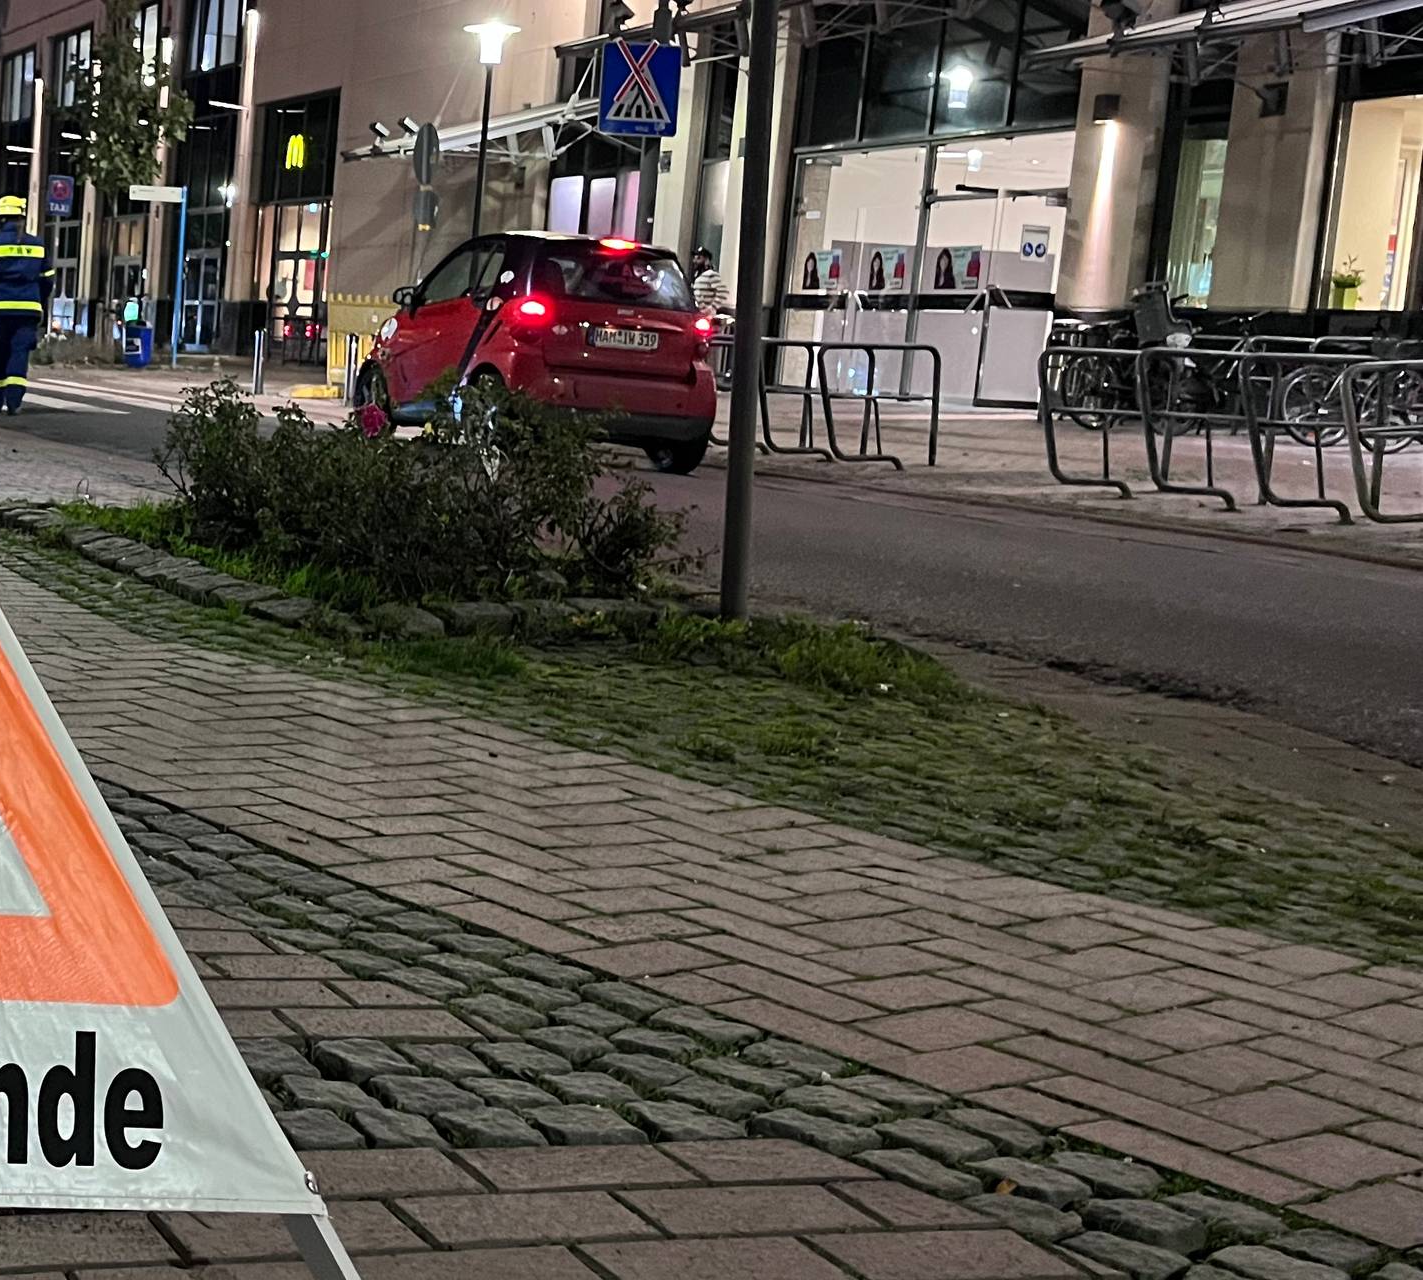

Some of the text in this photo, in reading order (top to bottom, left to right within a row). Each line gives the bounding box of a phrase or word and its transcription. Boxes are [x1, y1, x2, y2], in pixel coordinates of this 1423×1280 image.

[49, 202, 70, 213] TAXI
[595, 329, 617, 343] HAM
[638, 333, 657, 347] 319
